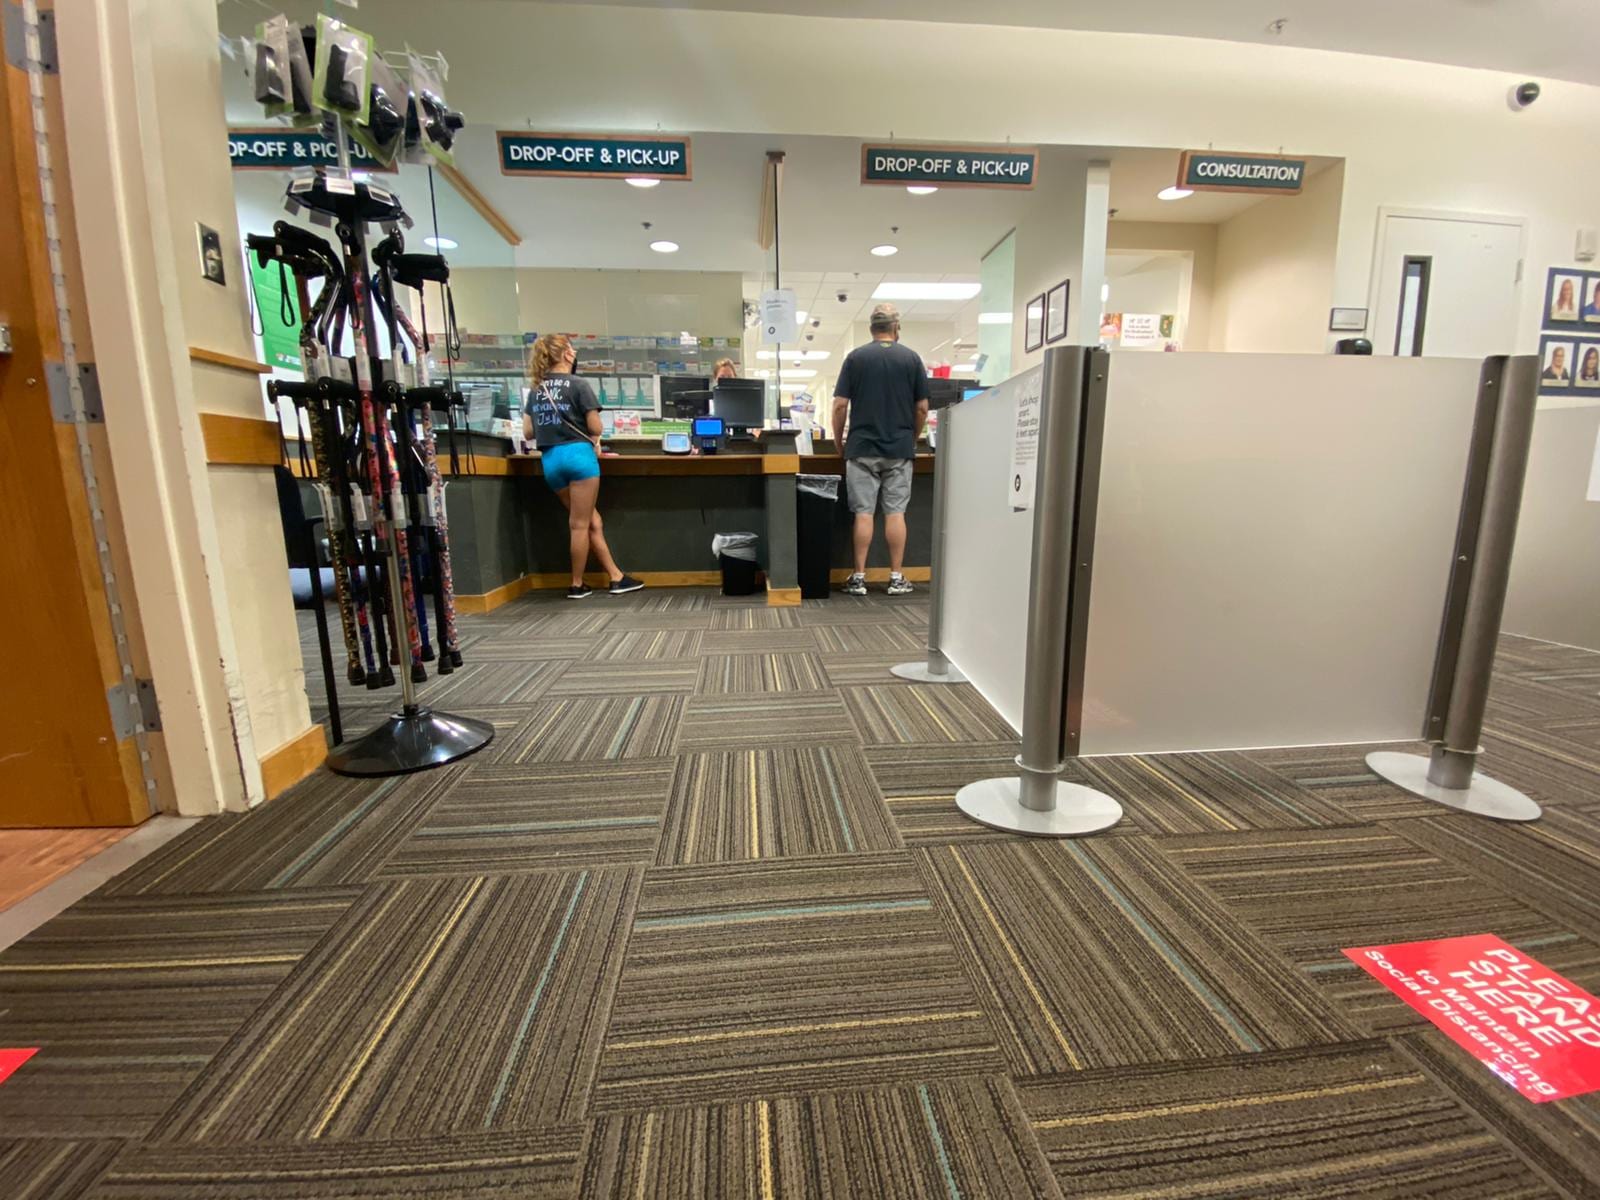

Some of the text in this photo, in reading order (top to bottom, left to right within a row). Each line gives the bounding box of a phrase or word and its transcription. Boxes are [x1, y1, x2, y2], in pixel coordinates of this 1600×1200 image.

[228, 141, 287, 157] OP-OFF
[293, 141, 307, 157] &
[509, 145, 680, 166] DROP-OFF & PICK-UP
[874, 156, 1029, 176] DROP-OFF & PICK-UP
[1196, 161, 1300, 181] CONSULTATION
[1363, 950, 1558, 1096] Social Distancing
[1415, 969, 1541, 1059] to Maintain
[1448, 970, 1572, 1047] HERE
[1467, 959, 1600, 1048] STAND
